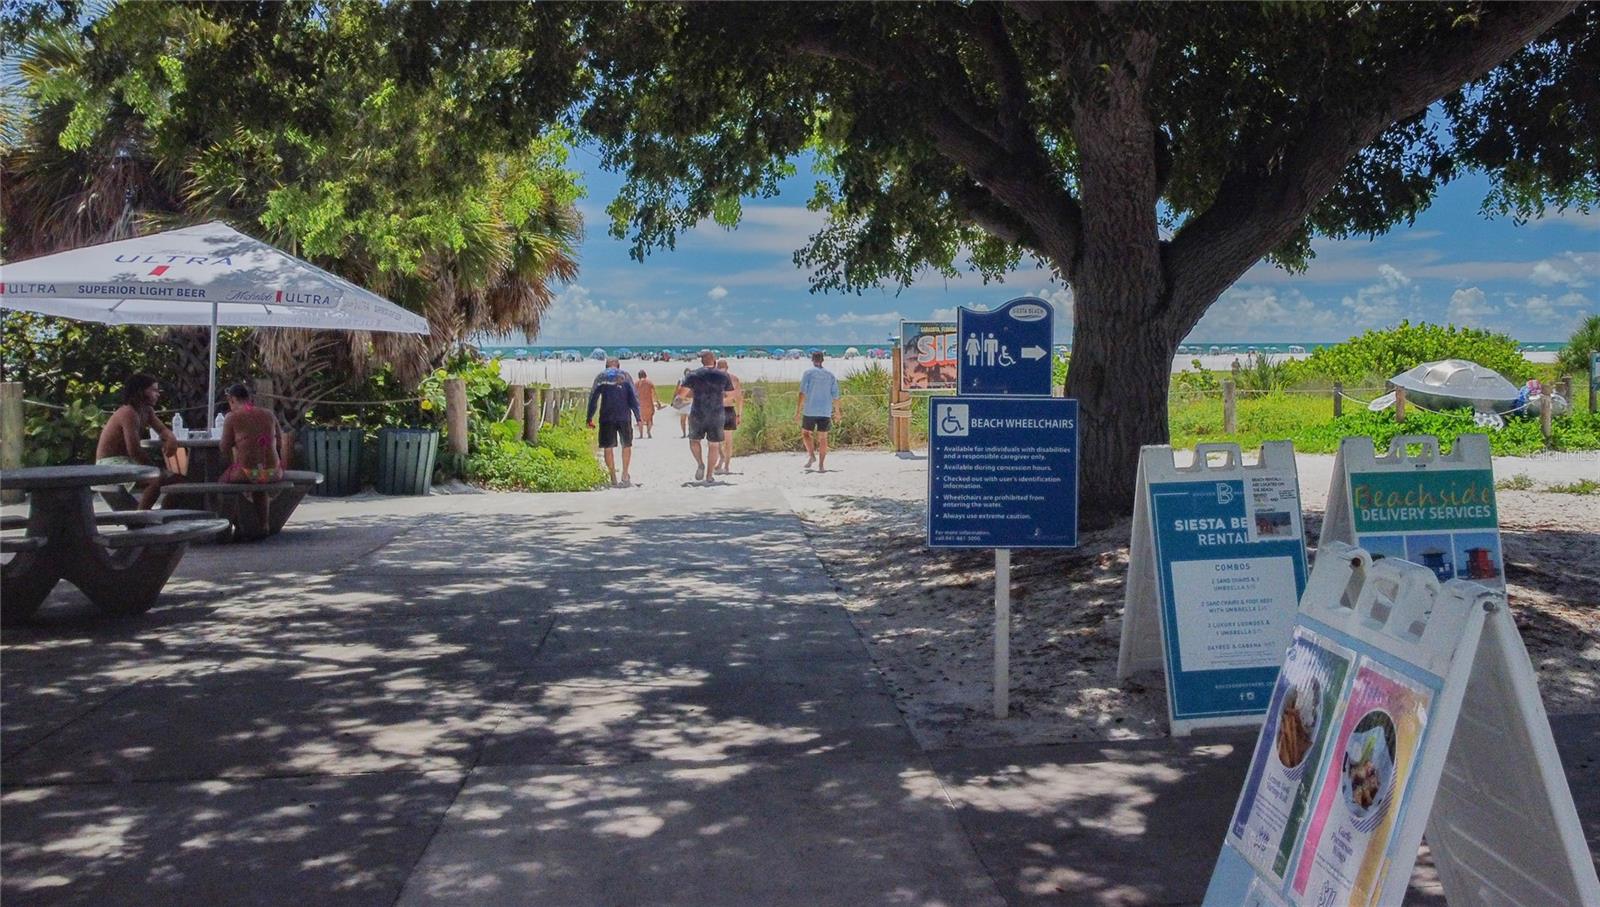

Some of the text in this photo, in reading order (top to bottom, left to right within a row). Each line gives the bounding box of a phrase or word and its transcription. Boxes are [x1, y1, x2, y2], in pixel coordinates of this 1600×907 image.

[115, 254, 231, 265] ULTRA
[9, 284, 57, 294] ULTRA
[78, 285, 206, 298] SUPERIOR LIGHT BEER
[285, 293, 330, 305] ULTRA
[971, 418, 1074, 429] BEACH WHEELCHAIRS
[962, 453, 999, 461] responsible
[1000, 454, 1030, 462] caregiver
[1354, 481, 1490, 511] Beachside
[1361, 505, 1491, 521] DELIVERY SERVICES
[1174, 518, 1226, 531] SIESTA
[1215, 563, 1250, 571] COMBOS
